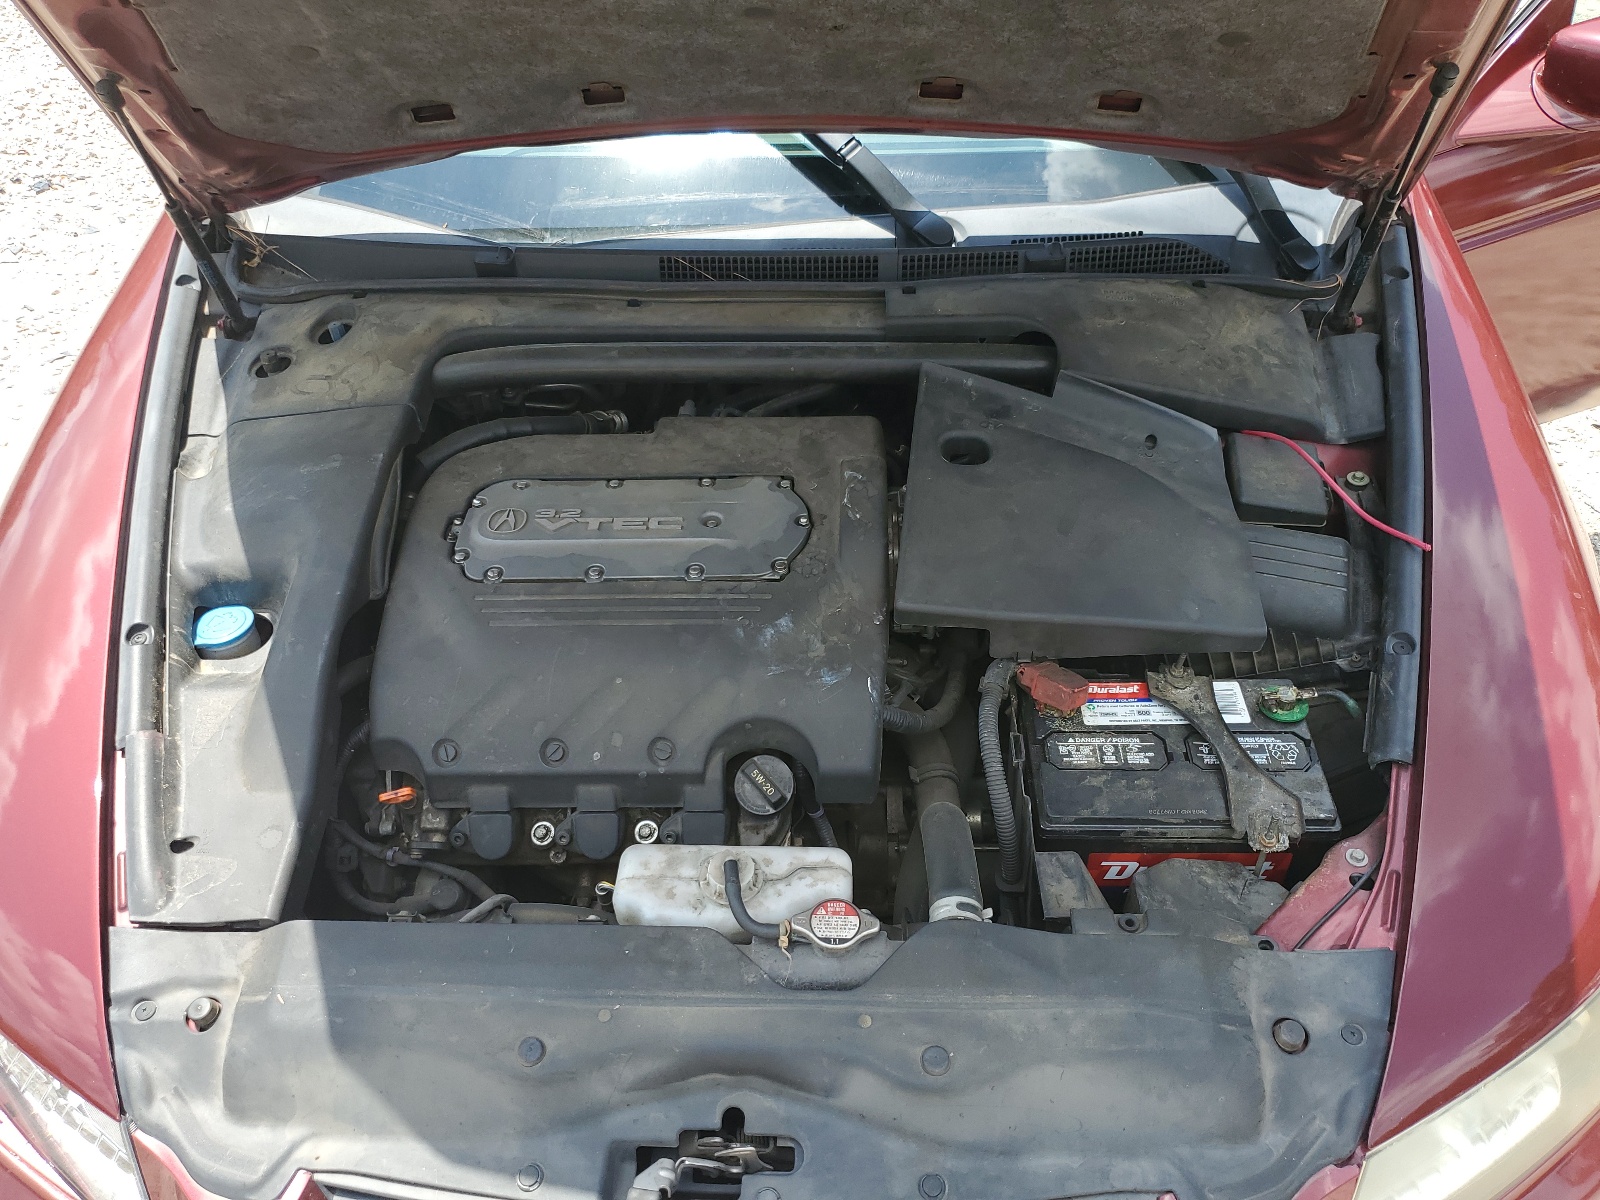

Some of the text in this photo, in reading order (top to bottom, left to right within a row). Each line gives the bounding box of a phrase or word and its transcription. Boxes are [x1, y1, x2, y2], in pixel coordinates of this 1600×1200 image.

[534, 508, 582, 518] 3.2
[534, 517, 684, 532] VTEC
[1088, 684, 1140, 694] Duralast
[750, 769, 775, 796] 5W-20
